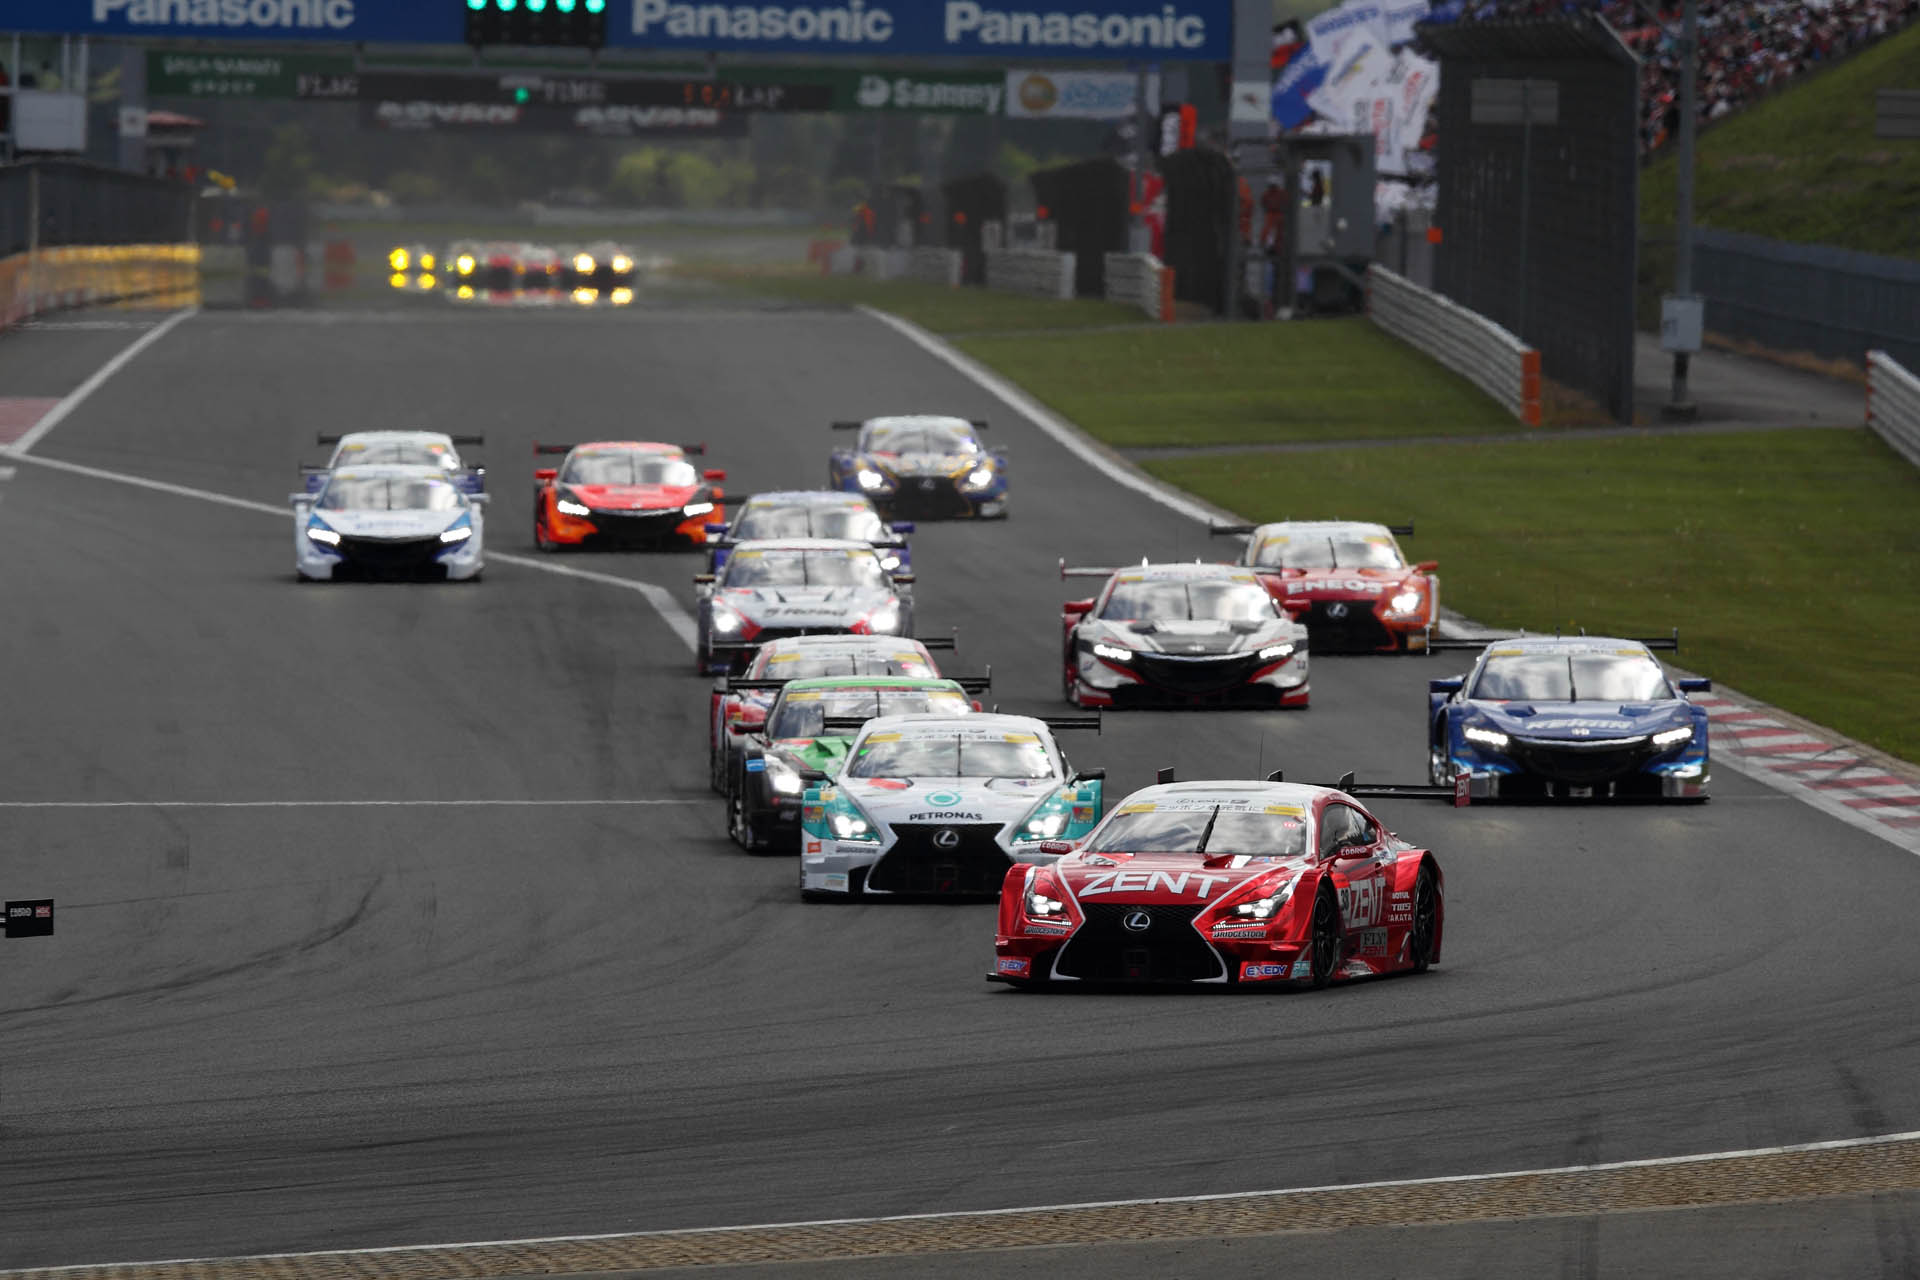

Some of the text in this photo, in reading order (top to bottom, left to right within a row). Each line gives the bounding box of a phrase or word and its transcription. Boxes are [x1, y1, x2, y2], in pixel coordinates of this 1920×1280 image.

[92, 0, 355, 28] Panasonic
[632, 0, 893, 41] Panasonic
[944, 1, 1205, 47] Panasonic
[895, 79, 1001, 114] Sammy
[1287, 580, 1383, 595] ENEOS
[909, 811, 983, 821] PETRONAS
[1078, 871, 1230, 899] ZENT
[1350, 878, 1386, 928] ZENT
[1212, 930, 1267, 939] BRIDGESTONE
[1245, 964, 1288, 977] EXEDY
